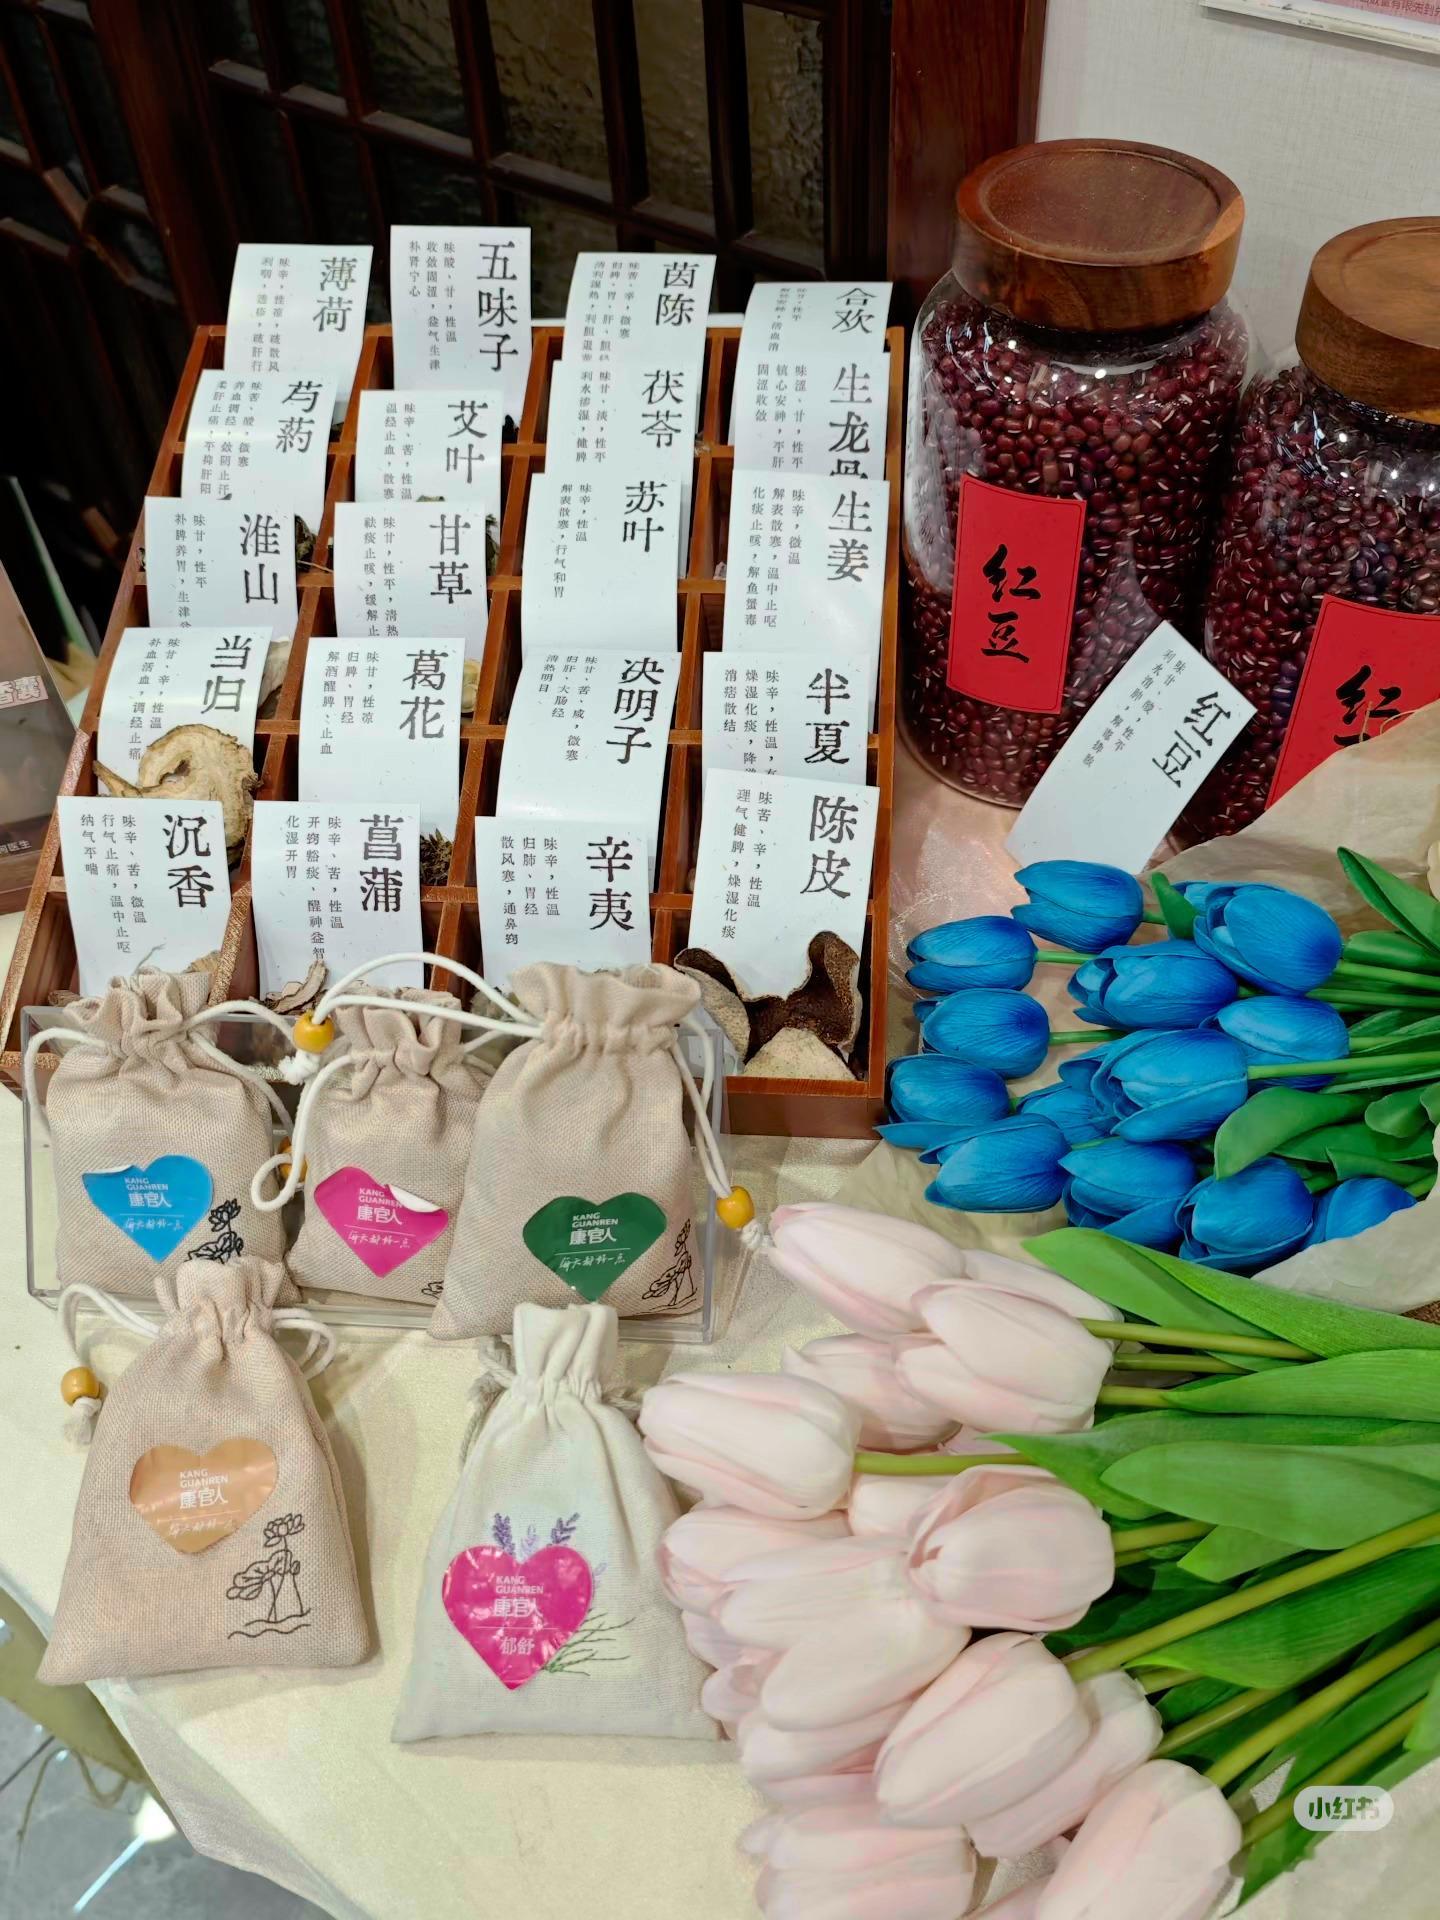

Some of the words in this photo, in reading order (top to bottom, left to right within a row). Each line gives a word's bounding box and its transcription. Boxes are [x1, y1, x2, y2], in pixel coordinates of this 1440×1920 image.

[312, 256, 358, 332] 薄荷
[477, 241, 519, 372] 五味子
[656, 262, 700, 326] 茵陈
[832, 287, 877, 334] 合欢
[446, 400, 488, 484] 艾叶
[641, 369, 684, 448] 茯苓
[622, 481, 667, 553] 苏叶
[827, 490, 872, 582] 生姜
[240, 514, 280, 605] 淮山
[429, 514, 472, 604] 甘草
[981, 543, 1042, 664] 红豆
[200, 635, 252, 714] 当归
[399, 649, 449, 740] 葛花
[606, 657, 664, 764] 决明子
[1333, 664, 1403, 746] 红
[804, 668, 851, 764] 半夏
[1151, 691, 1231, 789] 红豆
[162, 814, 214, 908] 沉香
[359, 814, 404, 912] 菖蒲
[586, 836, 634, 931] 辛夷
[800, 795, 859, 899] 陈皮
[124, 1177, 150, 1186] KANG
[126, 1182, 169, 1192] GUANREN
[128, 1192, 172, 1209] 康官人
[357, 1206, 403, 1225] 康官人
[359, 1187, 385, 1197] KANG
[572, 1212, 601, 1221] KANG
[569, 1227, 617, 1246] 康官人
[572, 1218, 619, 1229] GUANREN
[179, 1470, 208, 1479] KANG
[179, 1475, 229, 1489] GUANREN
[179, 1488, 229, 1510] 康官人
[493, 1597, 543, 1619] 康官人
[495, 1585, 544, 1595] GUANREN
[496, 1575, 525, 1586] KANG
[500, 1636, 536, 1656] 郁舒
